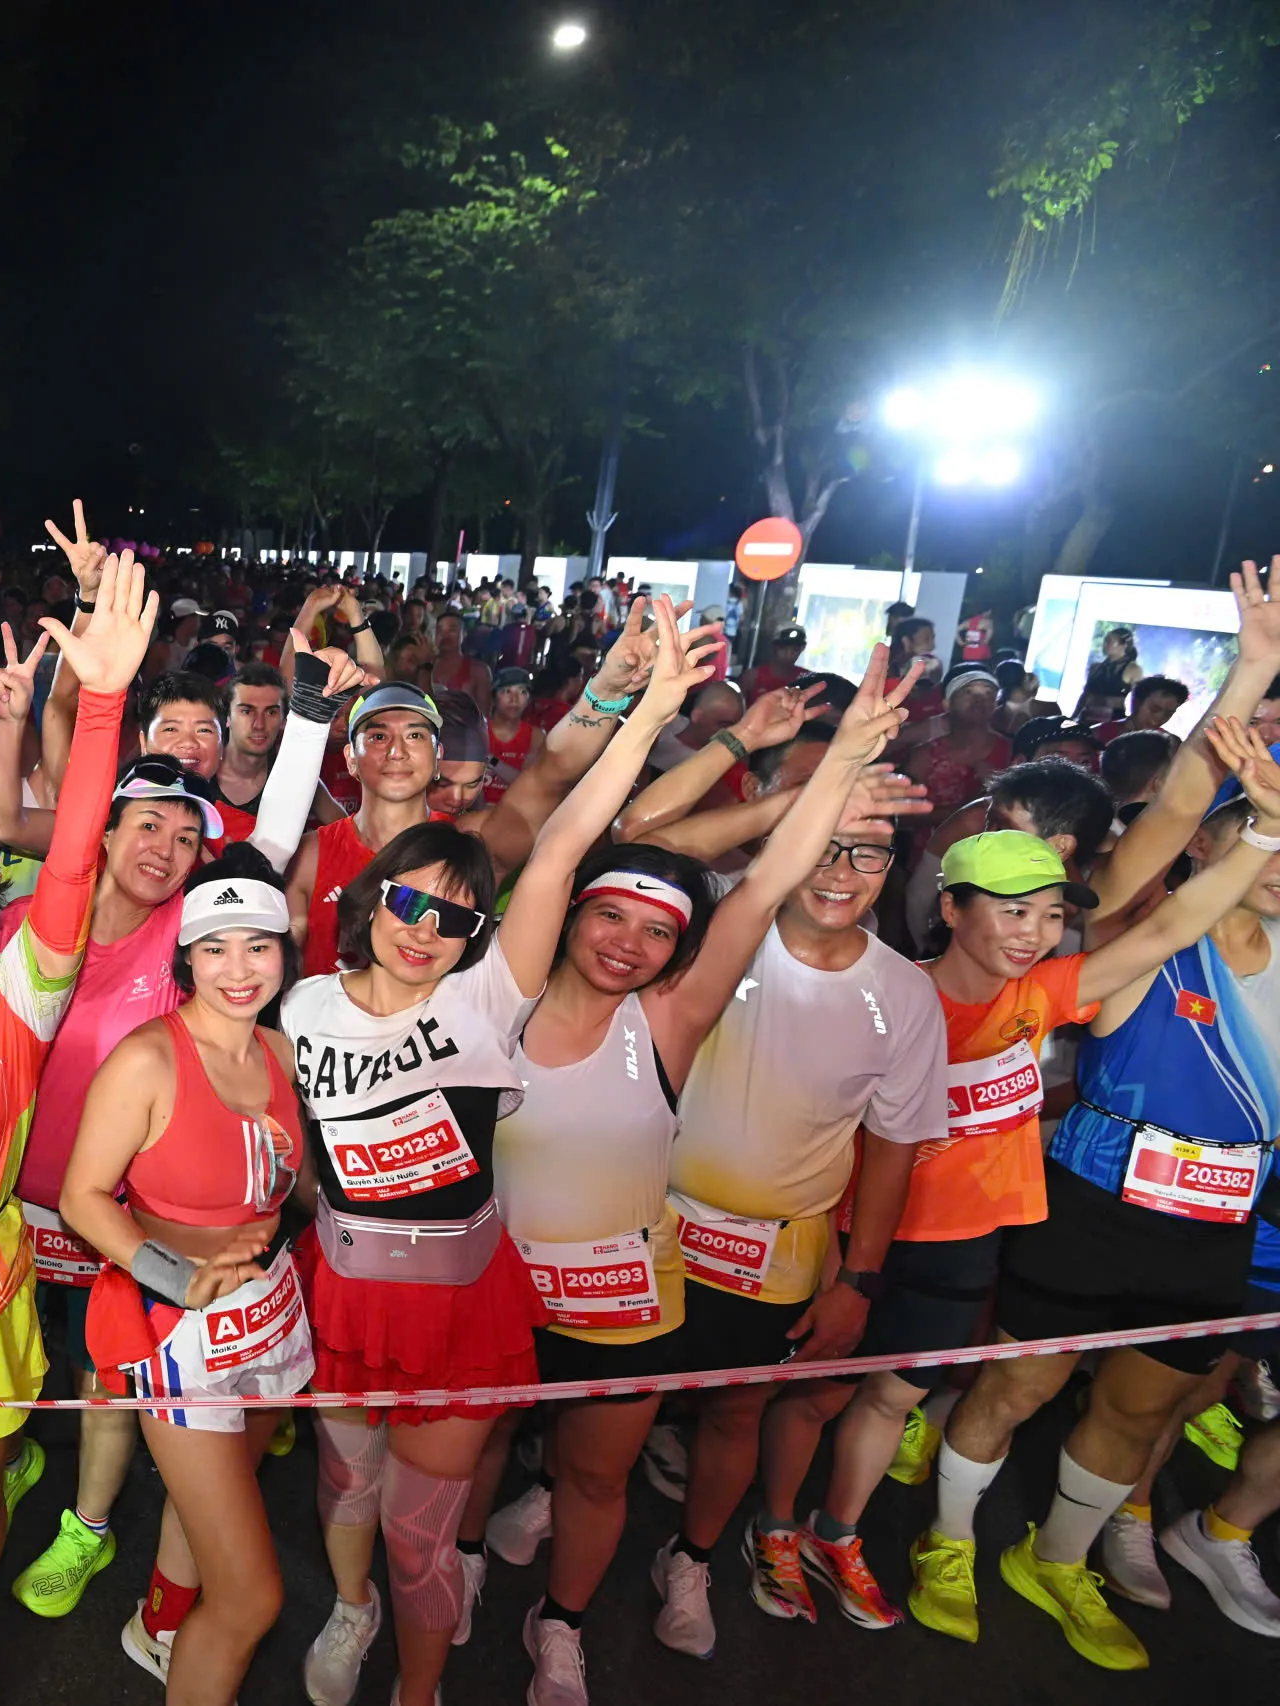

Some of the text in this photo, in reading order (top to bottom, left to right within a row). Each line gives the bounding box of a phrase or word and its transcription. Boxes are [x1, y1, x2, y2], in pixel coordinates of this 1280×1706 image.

[213, 897, 244, 906] adidas
[975, 1069, 1035, 1103] 203388
[965, 1128, 997, 1136] MARATHON
[345, 1150, 370, 1172] A
[376, 1127, 449, 1162] 201281
[441, 1152, 469, 1167] Female
[1184, 1164, 1251, 1189] 203382
[687, 1228, 760, 1259] 200109
[529, 1267, 644, 1293] B 200693
[742, 1270, 761, 1280] Male
[215, 1315, 241, 1340] A
[249, 1274, 292, 1323] 201540
[627, 1298, 654, 1307] Female
[211, 1344, 238, 1355] MaiKa
